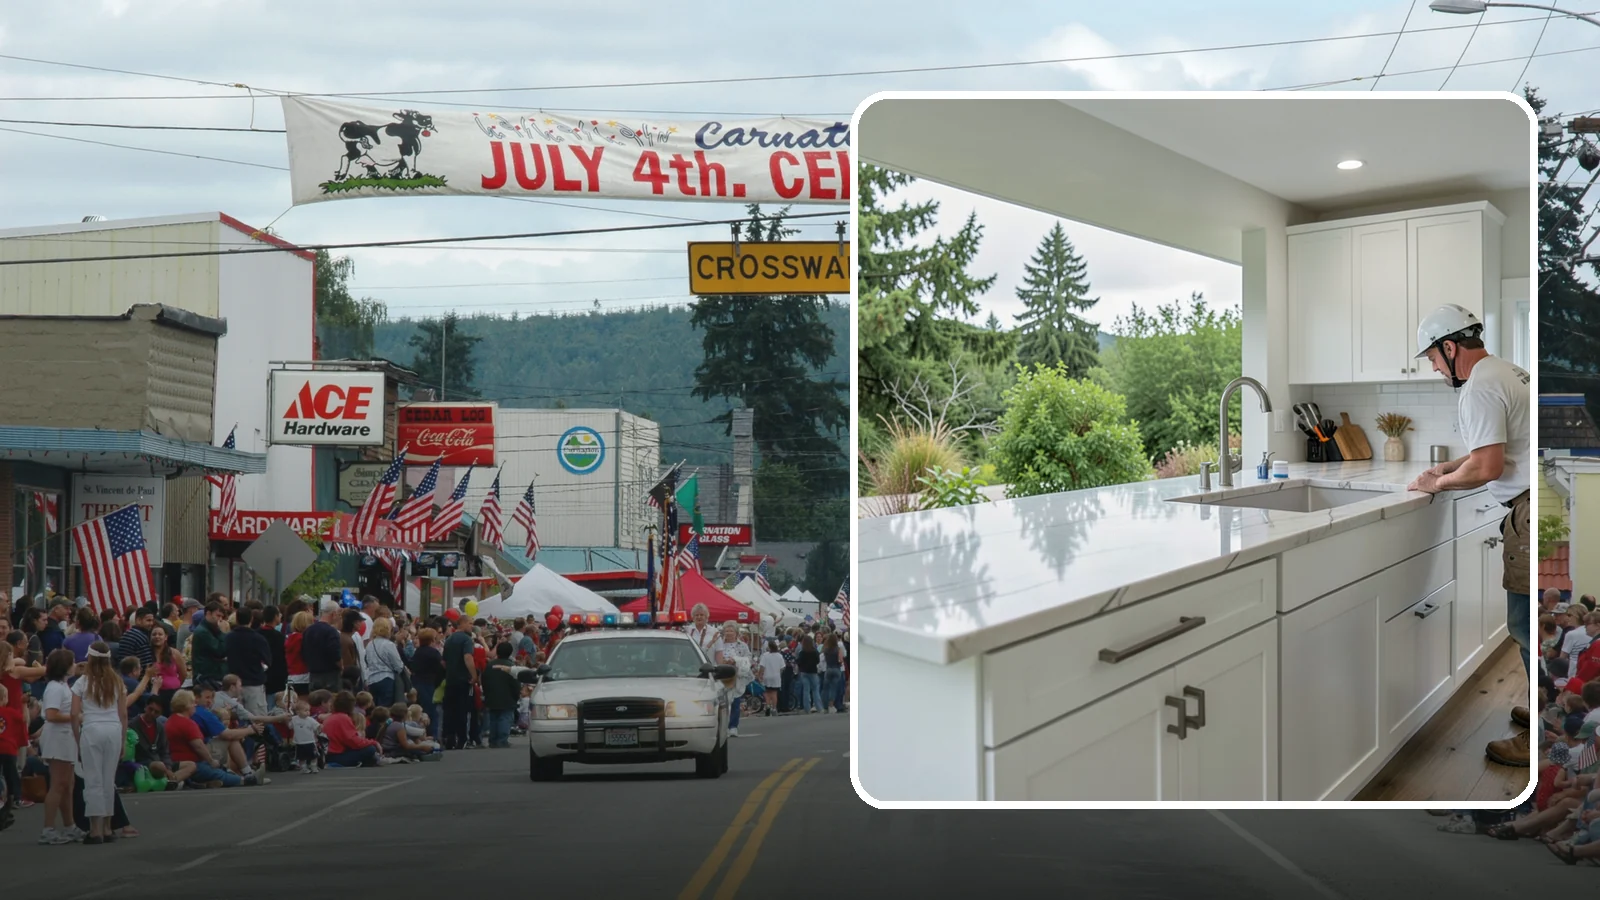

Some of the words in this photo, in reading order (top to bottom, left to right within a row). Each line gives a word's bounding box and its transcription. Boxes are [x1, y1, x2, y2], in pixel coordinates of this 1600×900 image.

[481, 141, 604, 192] JULY
[632, 150, 746, 198] 4th.
[697, 254, 850, 280] CROSSWA
[283, 380, 373, 420] ACE
[406, 409, 452, 422] CEDAR
[283, 421, 371, 436] Hardware
[416, 428, 476, 447] Coca-Cola
[354, 467, 384, 480] Simpl
[96, 485, 124, 495] Vincent
[126, 486, 136, 495] de
[138, 486, 155, 495] Paul
[688, 526, 741, 535] CRNATION
[699, 535, 730, 543] GLASS
